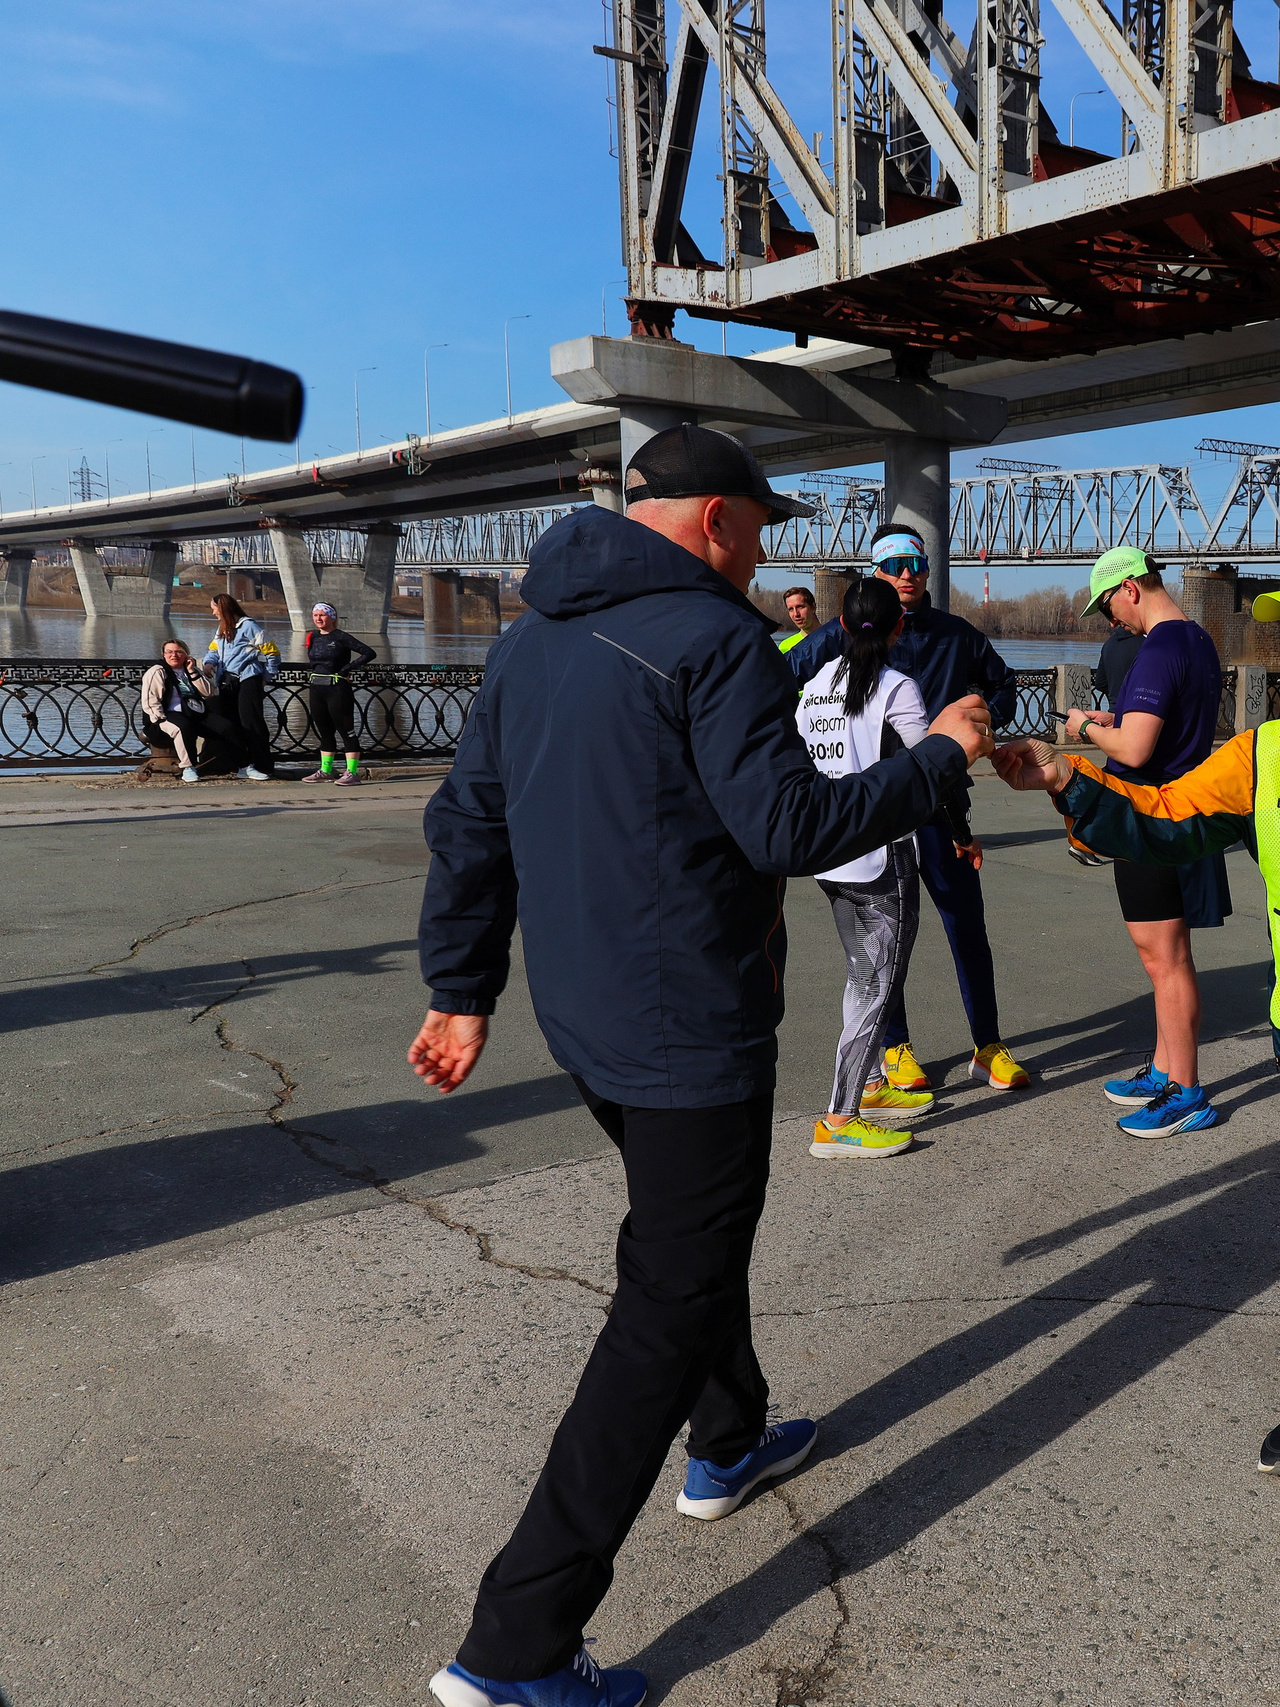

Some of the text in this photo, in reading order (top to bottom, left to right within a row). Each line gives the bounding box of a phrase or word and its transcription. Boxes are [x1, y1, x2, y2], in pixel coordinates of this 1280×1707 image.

[803, 691, 847, 709] ейсмейк
[809, 741, 844, 760] 30:00
[830, 1132, 862, 1146] HOKA
